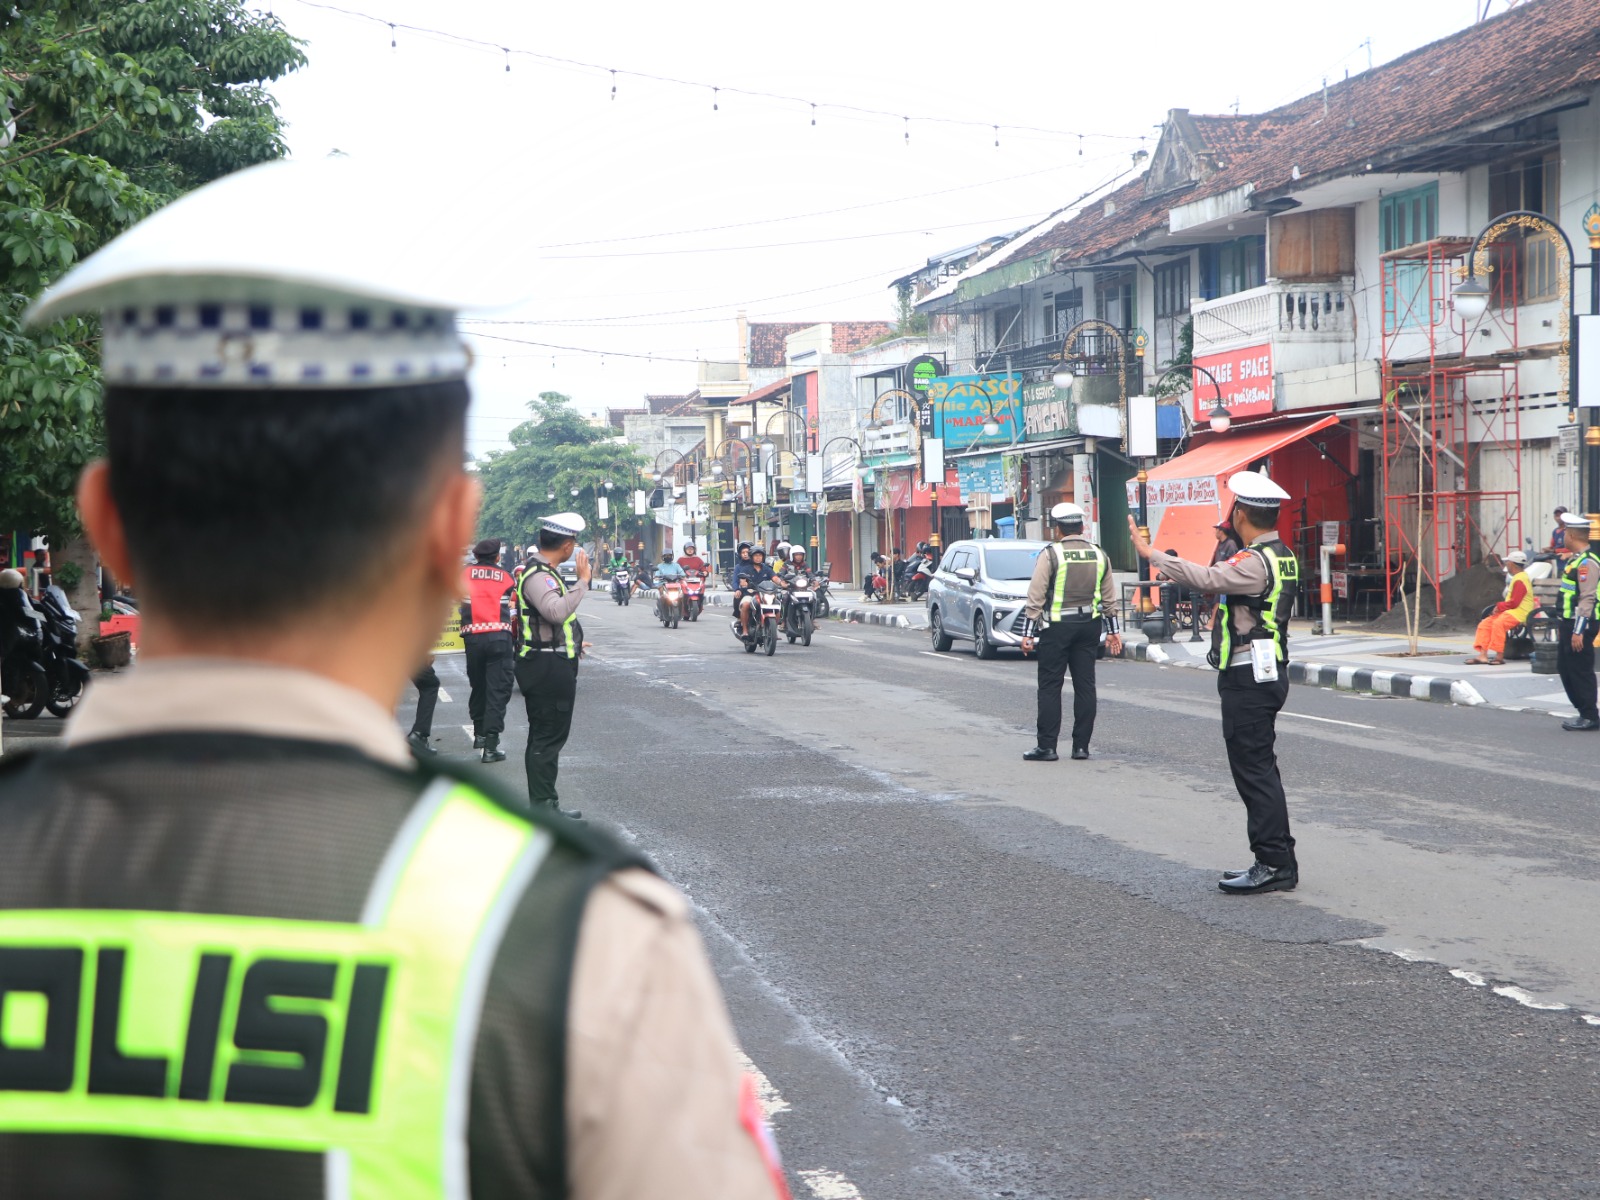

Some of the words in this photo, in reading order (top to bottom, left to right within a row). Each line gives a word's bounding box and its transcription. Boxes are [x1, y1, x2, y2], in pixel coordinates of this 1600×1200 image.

[1197, 363, 1233, 387] VINTAGE
[1240, 356, 1269, 380] SPACE
[933, 378, 1019, 398] BAKSO
[935, 401, 966, 413] Mie
[945, 415, 1012, 428] "MARM"
[1063, 551, 1098, 561] POLISI
[471, 568, 504, 582] POLISI
